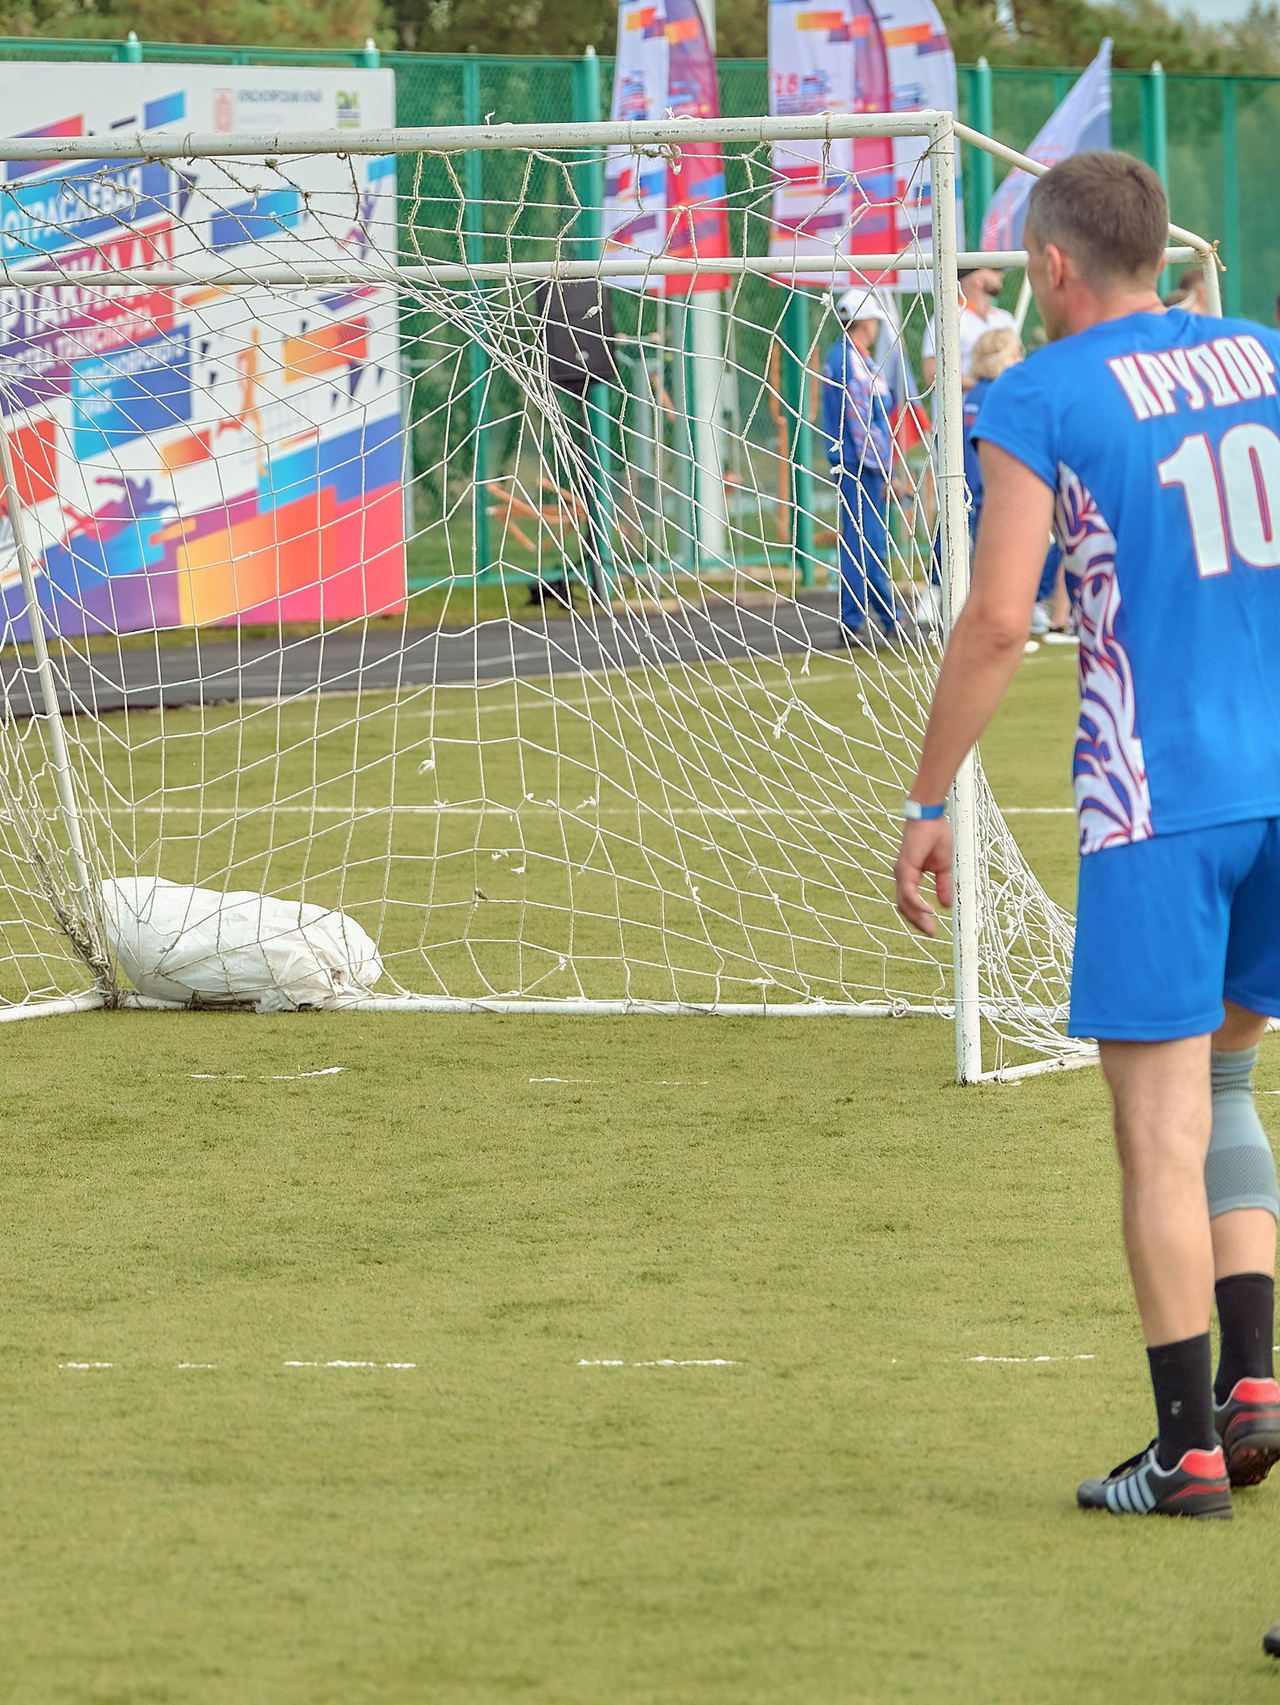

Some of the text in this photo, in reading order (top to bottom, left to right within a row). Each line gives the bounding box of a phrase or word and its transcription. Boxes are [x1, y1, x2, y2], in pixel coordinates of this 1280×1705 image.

[3, 168, 143, 253] ОТРАСЛЕВАЯ
[1107, 334, 1277, 421] КРУДОР
[1157, 422, 1280, 579] 10
